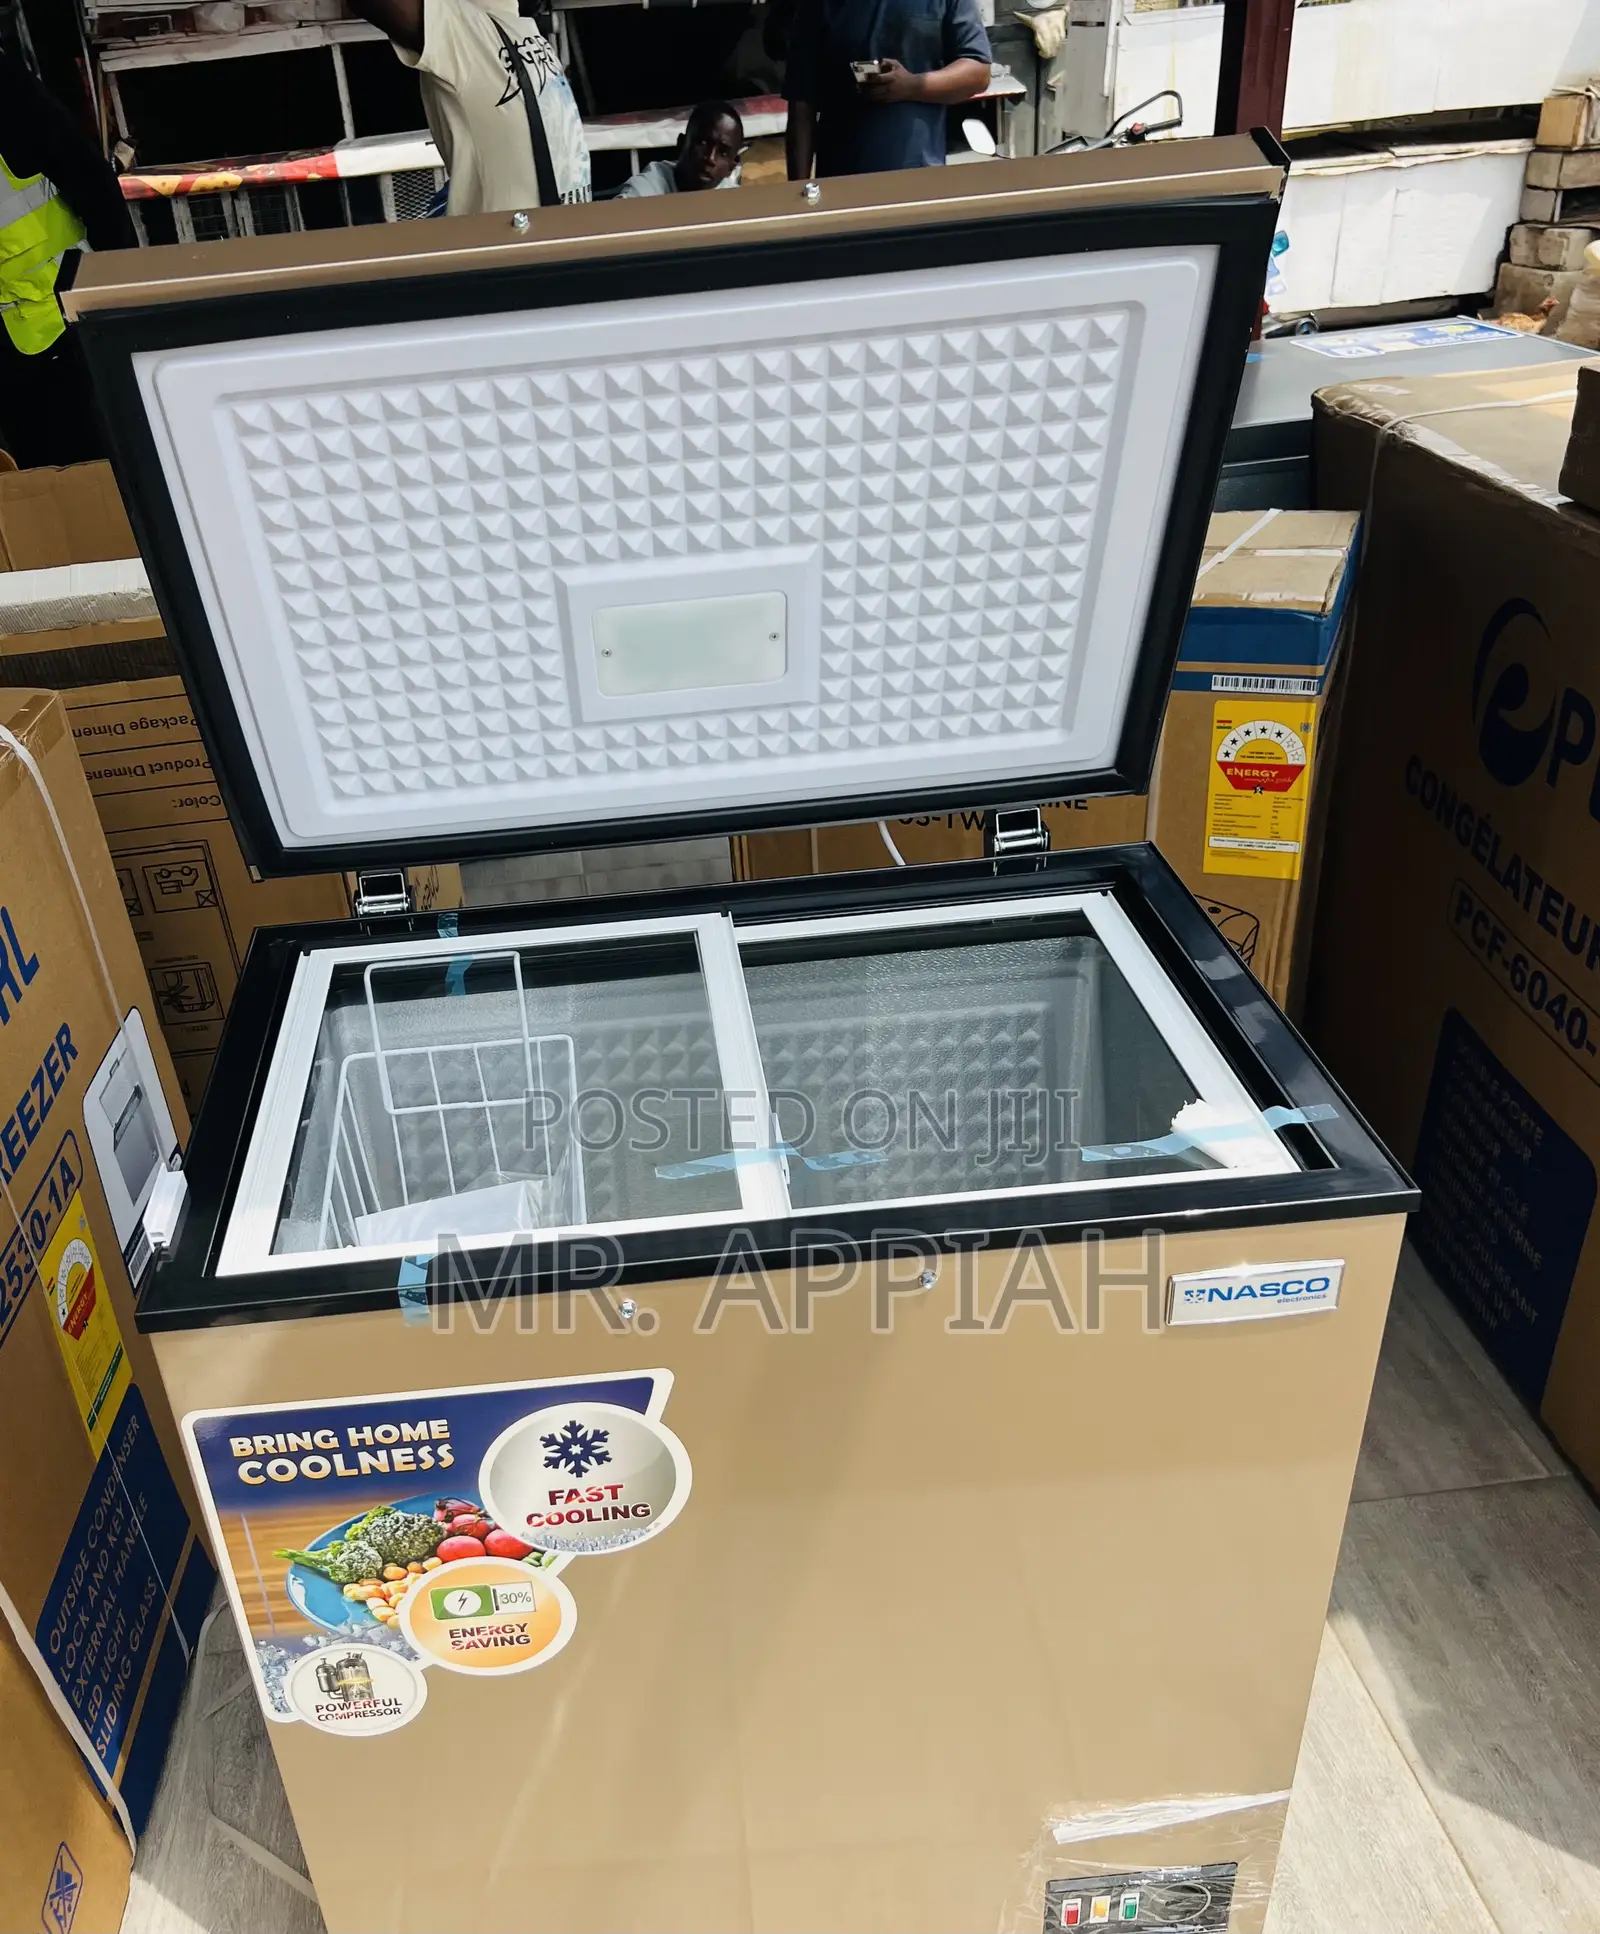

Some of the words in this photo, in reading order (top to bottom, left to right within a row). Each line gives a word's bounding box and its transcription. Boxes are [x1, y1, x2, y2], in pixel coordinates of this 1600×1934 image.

[1226, 767, 1278, 778] ENERGY
[172, 795, 222, 808] Color:
[1207, 1277, 1330, 1303] NASCO
[1276, 1294, 1328, 1304] electronics
[229, 1429, 340, 1457] BRING
[347, 1419, 450, 1447] HOME
[238, 1443, 455, 1485] COOLNESS
[548, 1484, 624, 1506] FAST
[526, 1503, 651, 1527] COOLING
[88, 1549, 109, 1607] AND
[107, 1500, 124, 1548] KEY
[50, 1549, 89, 1654] OUTSIDE
[72, 1587, 117, 1708] EXTERNAL
[113, 1492, 148, 1586] HANDLE
[499, 1591, 532, 1605] 30%
[449, 1623, 529, 1639] ENERGY
[451, 1634, 531, 1651] SAVING
[84, 1684, 103, 1735] LED
[101, 1608, 127, 1683] LIGHT
[96, 1654, 131, 1759] SLIDING
[129, 1576, 157, 1651] GLASS
[315, 1698, 403, 1713] POWERFUL
[317, 1708, 402, 1722] COMPRESSOR
